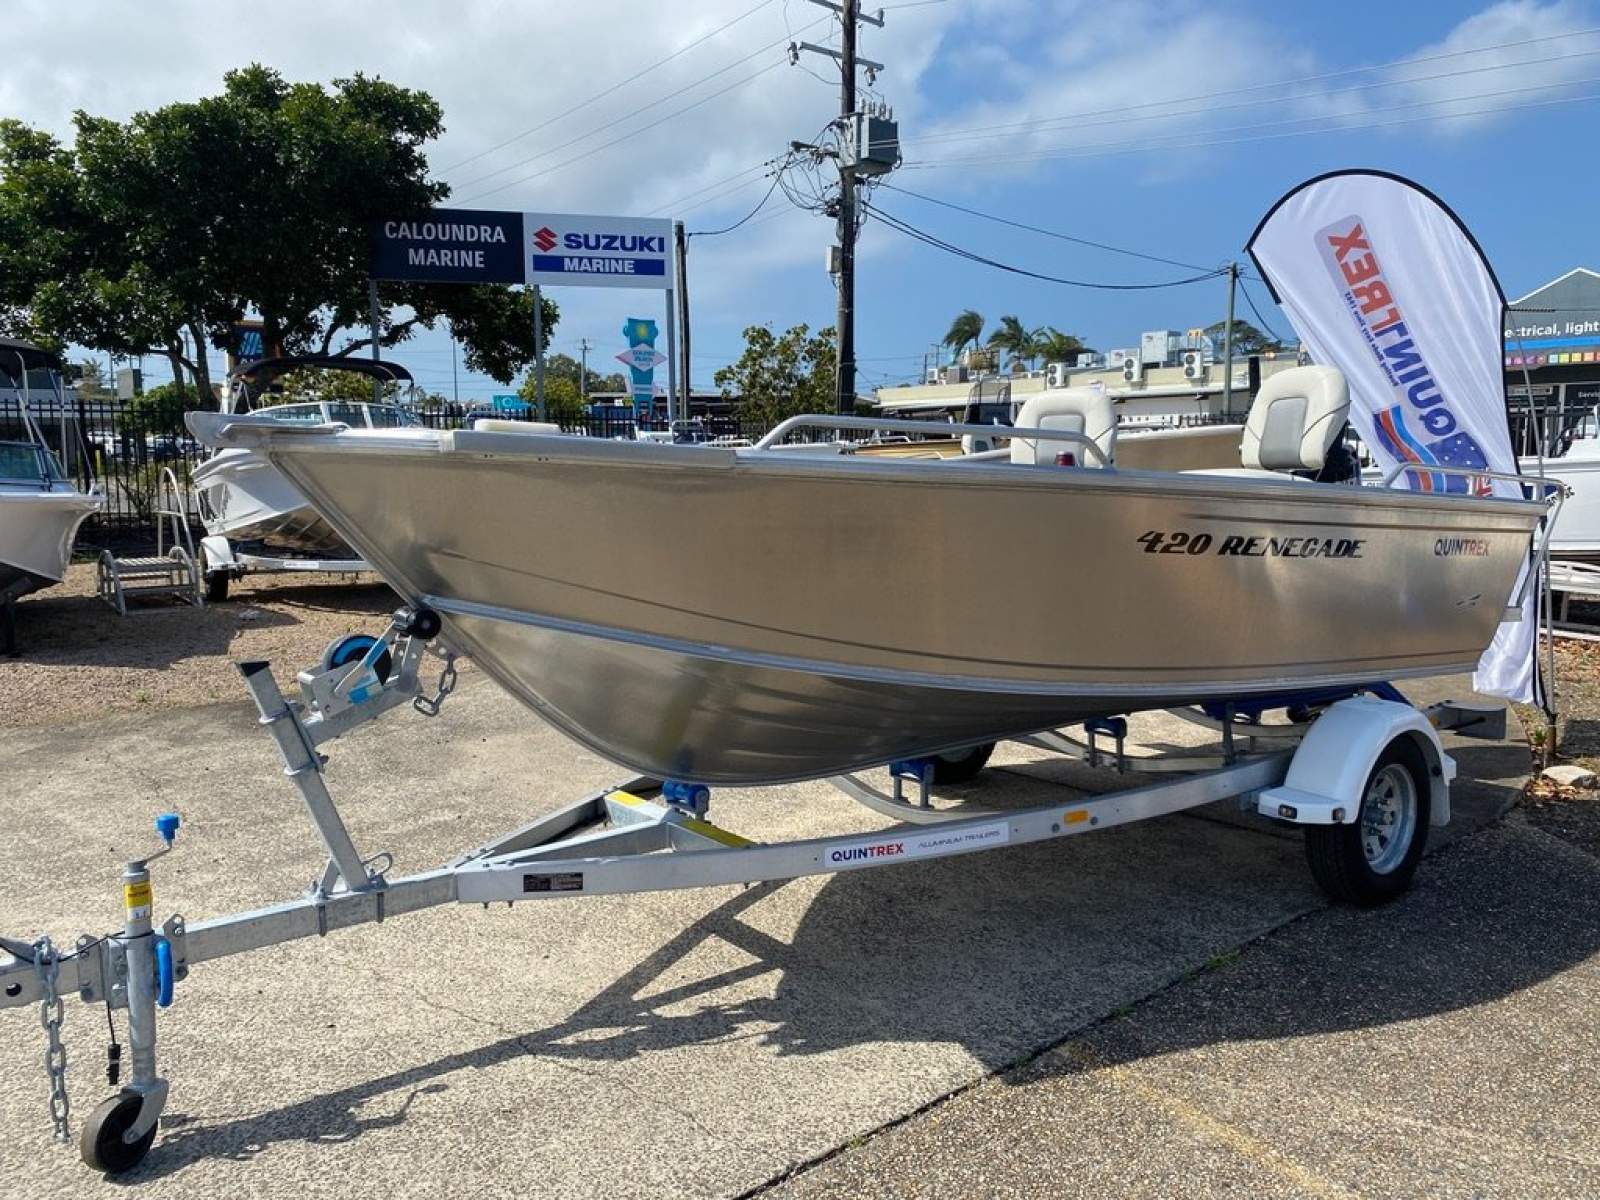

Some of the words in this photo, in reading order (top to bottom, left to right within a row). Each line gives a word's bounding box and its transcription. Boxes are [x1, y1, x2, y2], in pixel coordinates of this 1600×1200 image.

[384, 221, 506, 244] CALOUNDRA
[563, 233, 665, 253] SUZUKI
[408, 248, 485, 268] MARINE
[563, 257, 635, 273] MARINE
[1565, 321, 1600, 335] light
[1136, 531, 1212, 556] 420
[1217, 535, 1367, 558] RENEGADE
[1434, 538, 1490, 557] QUINTREX
[831, 842, 904, 862] QUINTREX
